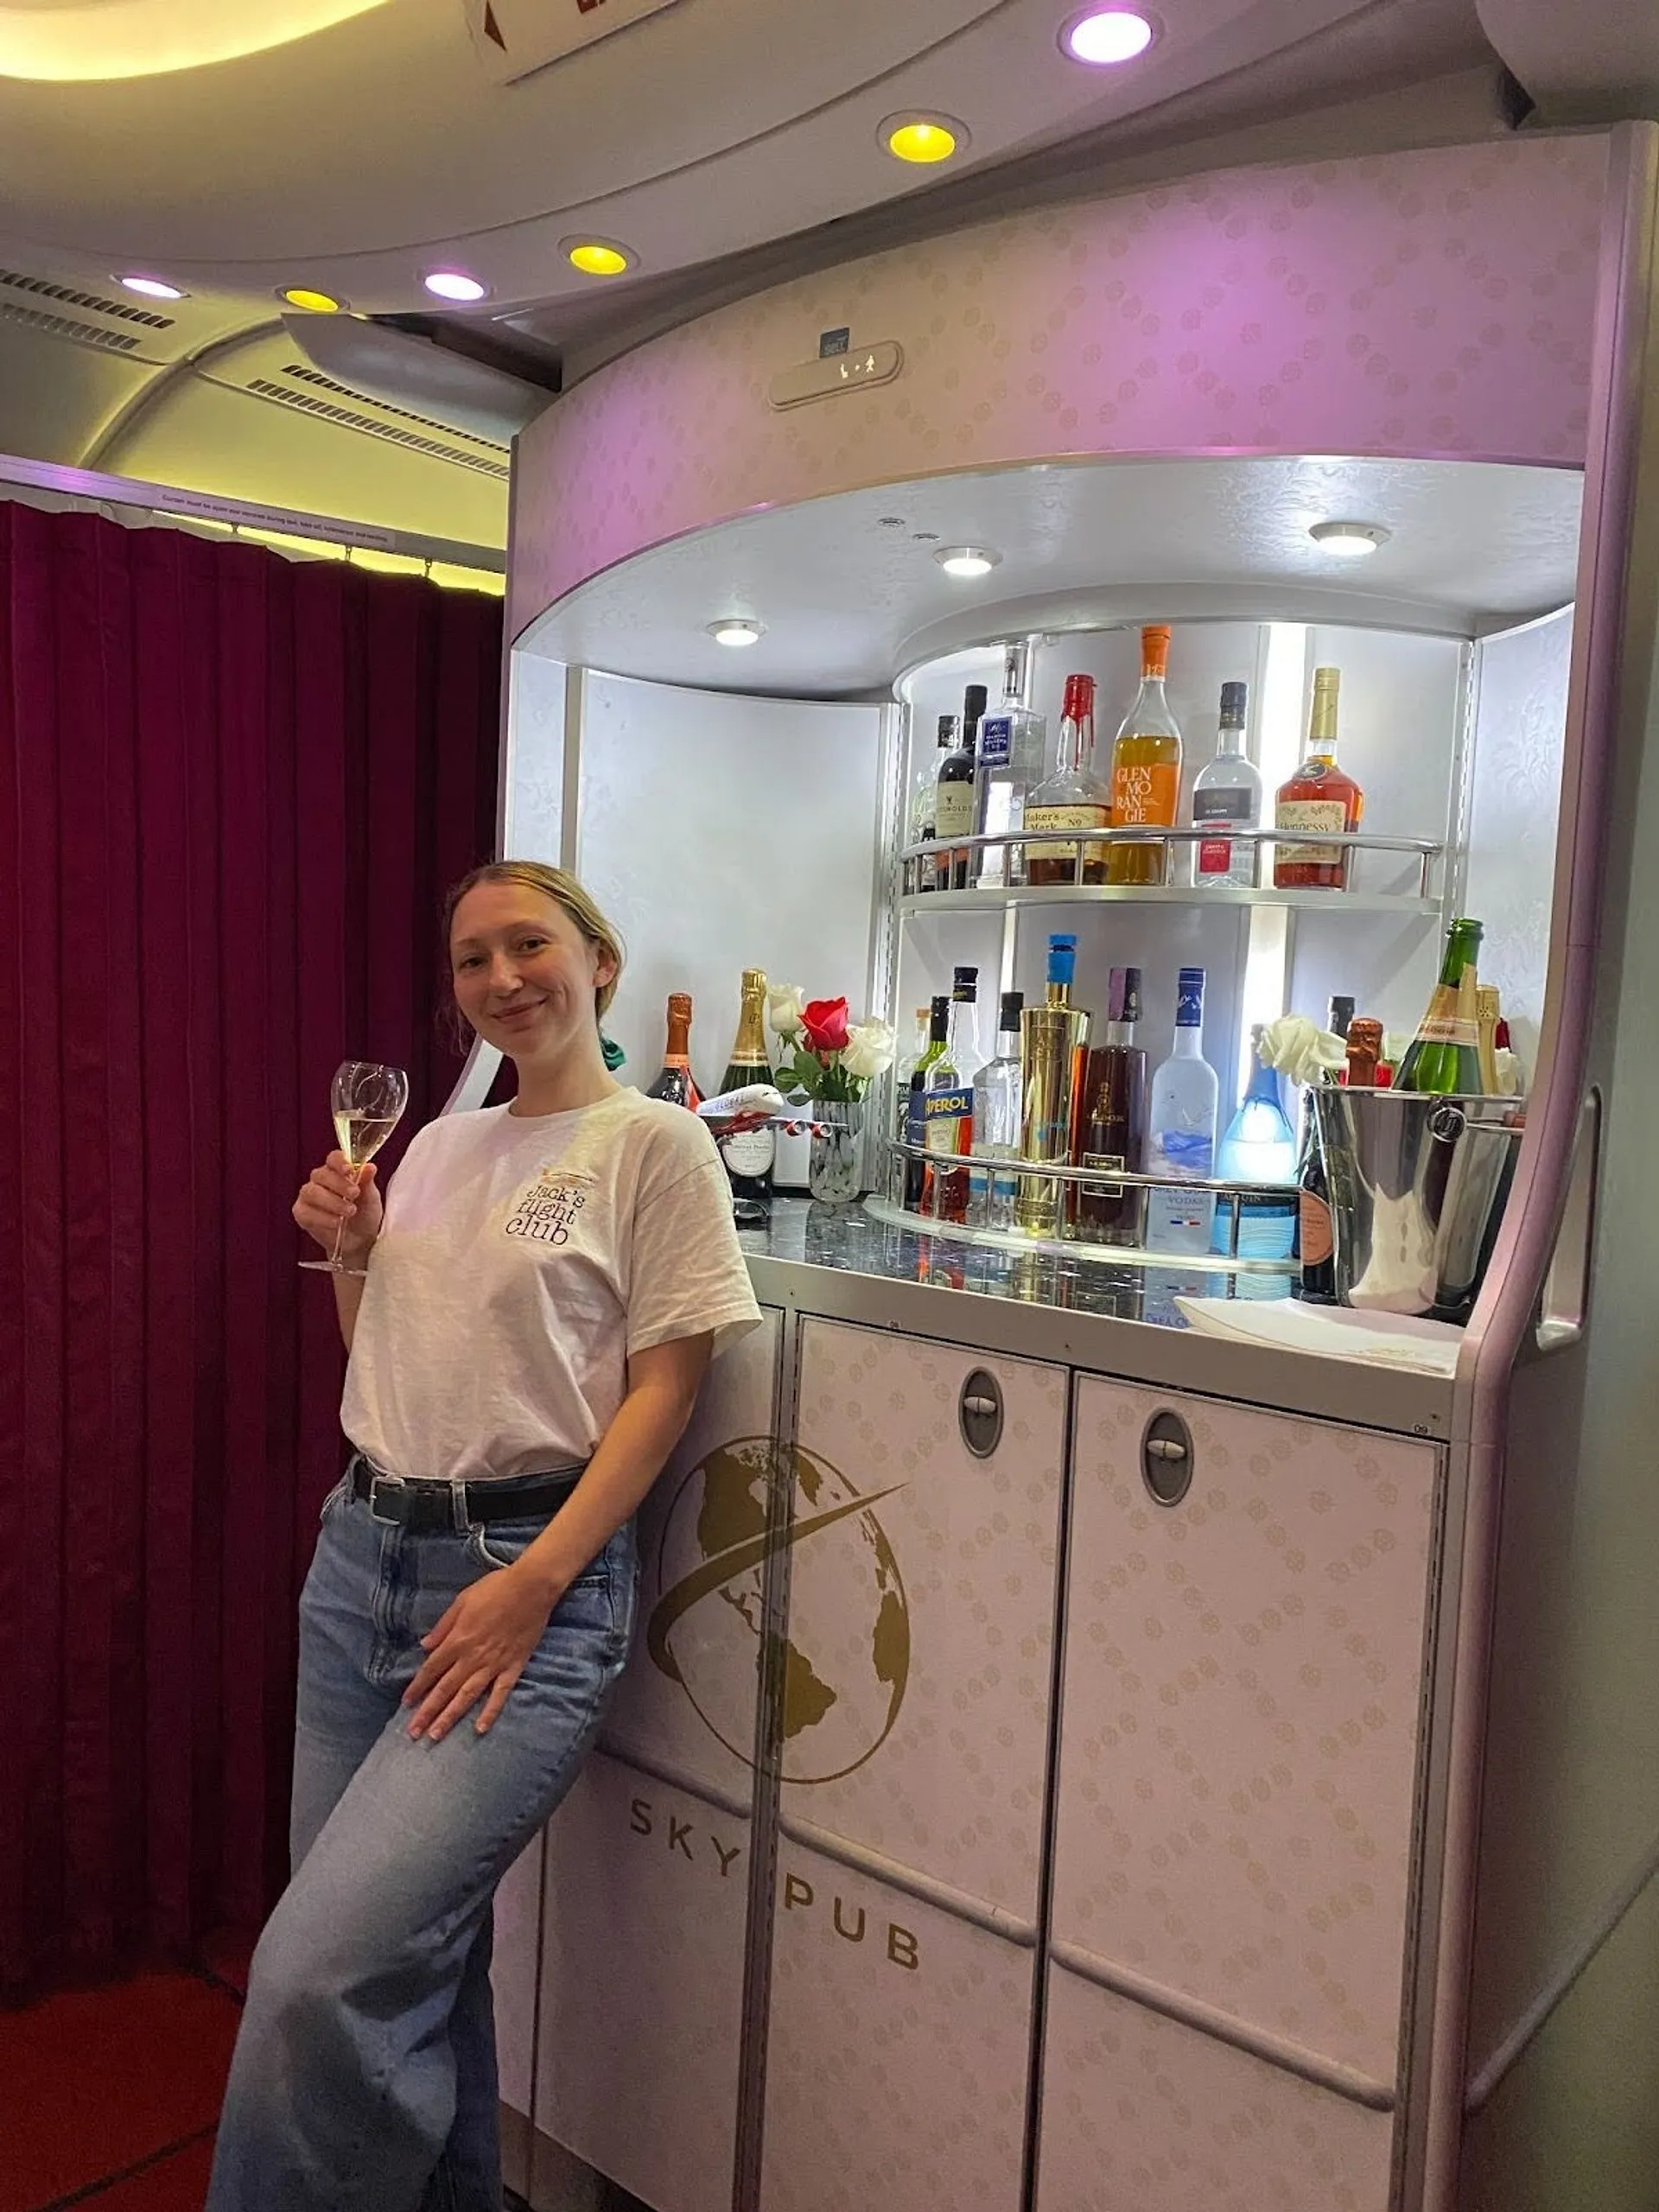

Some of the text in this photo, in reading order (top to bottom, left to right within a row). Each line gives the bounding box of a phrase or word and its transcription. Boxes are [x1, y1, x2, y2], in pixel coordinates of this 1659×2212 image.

[1117, 766, 1152, 783] GLEN
[1126, 780, 1152, 796] MO
[1116, 794, 1142, 810] RAN
[1124, 807, 1147, 823] GIE
[925, 1096, 969, 1116] APEROL
[526, 1184, 586, 1208] Jack's
[505, 1213, 569, 1245] club
[630, 1798, 919, 1970] SKY PUB
